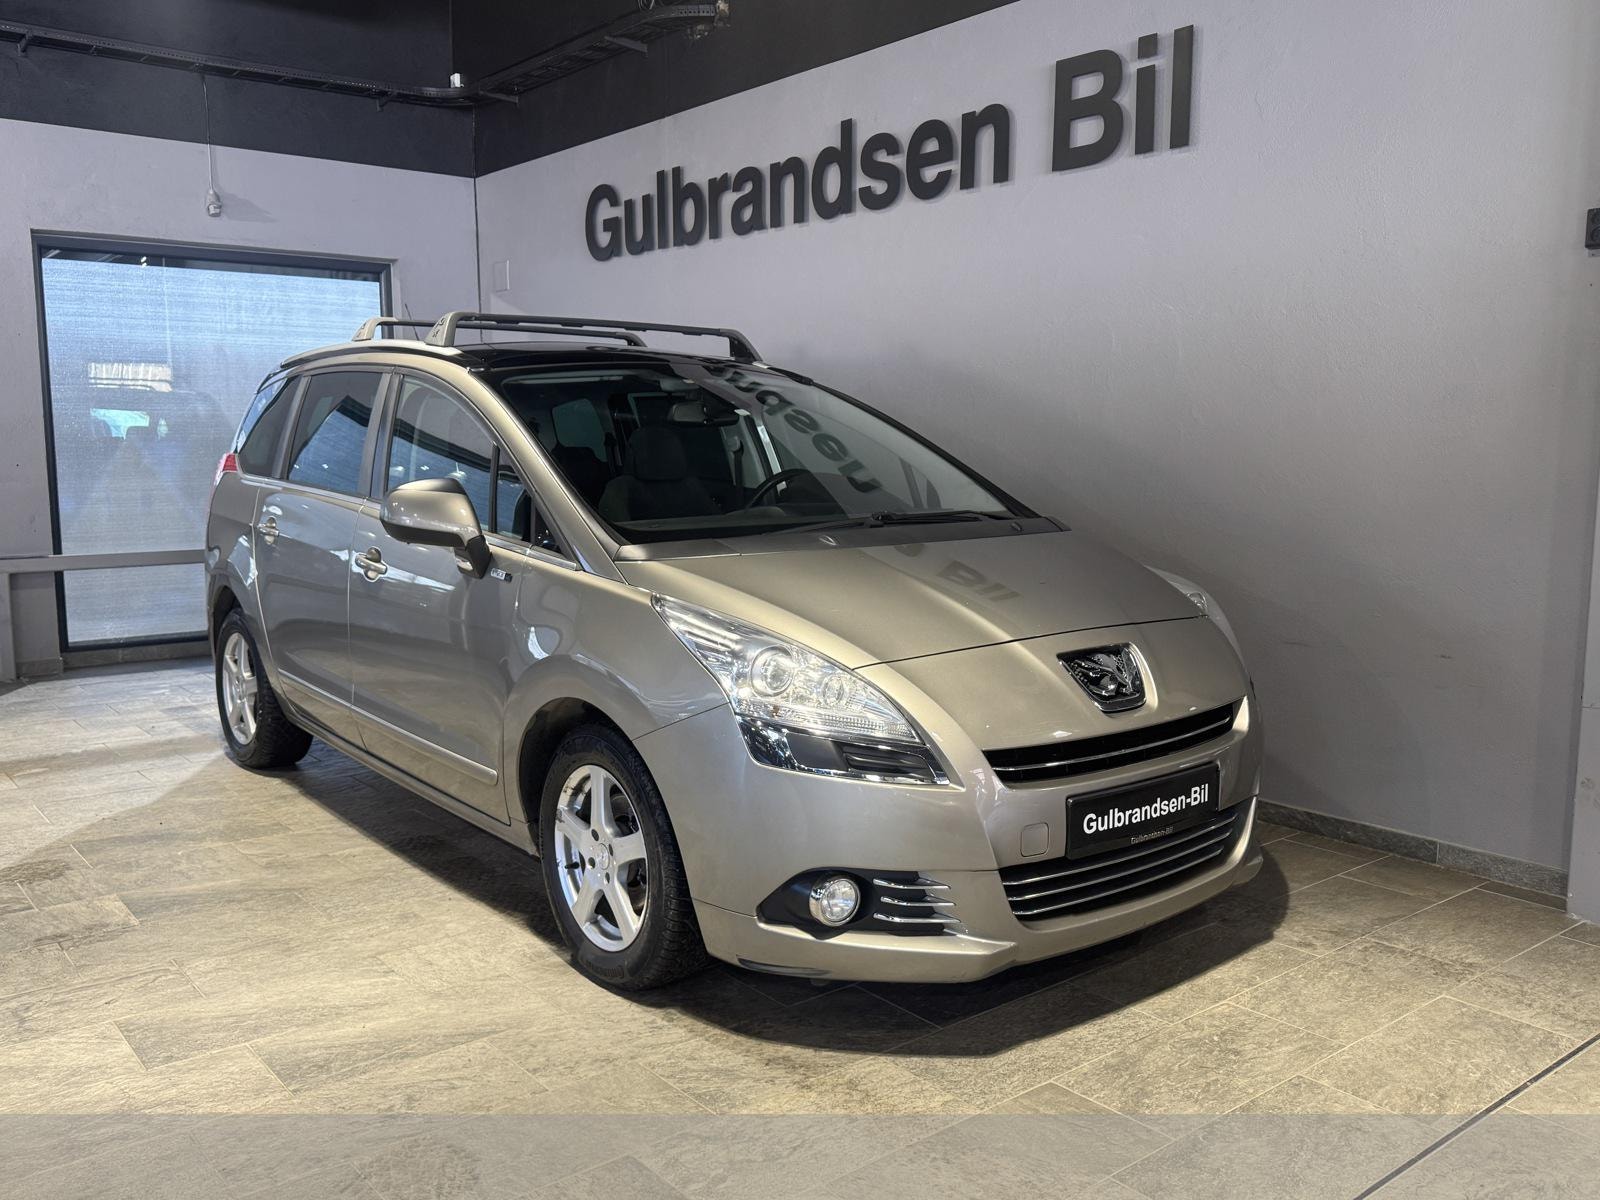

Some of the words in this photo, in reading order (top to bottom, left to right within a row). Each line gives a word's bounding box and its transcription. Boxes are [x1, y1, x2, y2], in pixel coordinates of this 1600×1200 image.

[585, 103, 1011, 262] Gulbrandsen
[1052, 24, 1195, 173] Bil
[1083, 783, 1209, 835] Gulbrandsen-Bil
